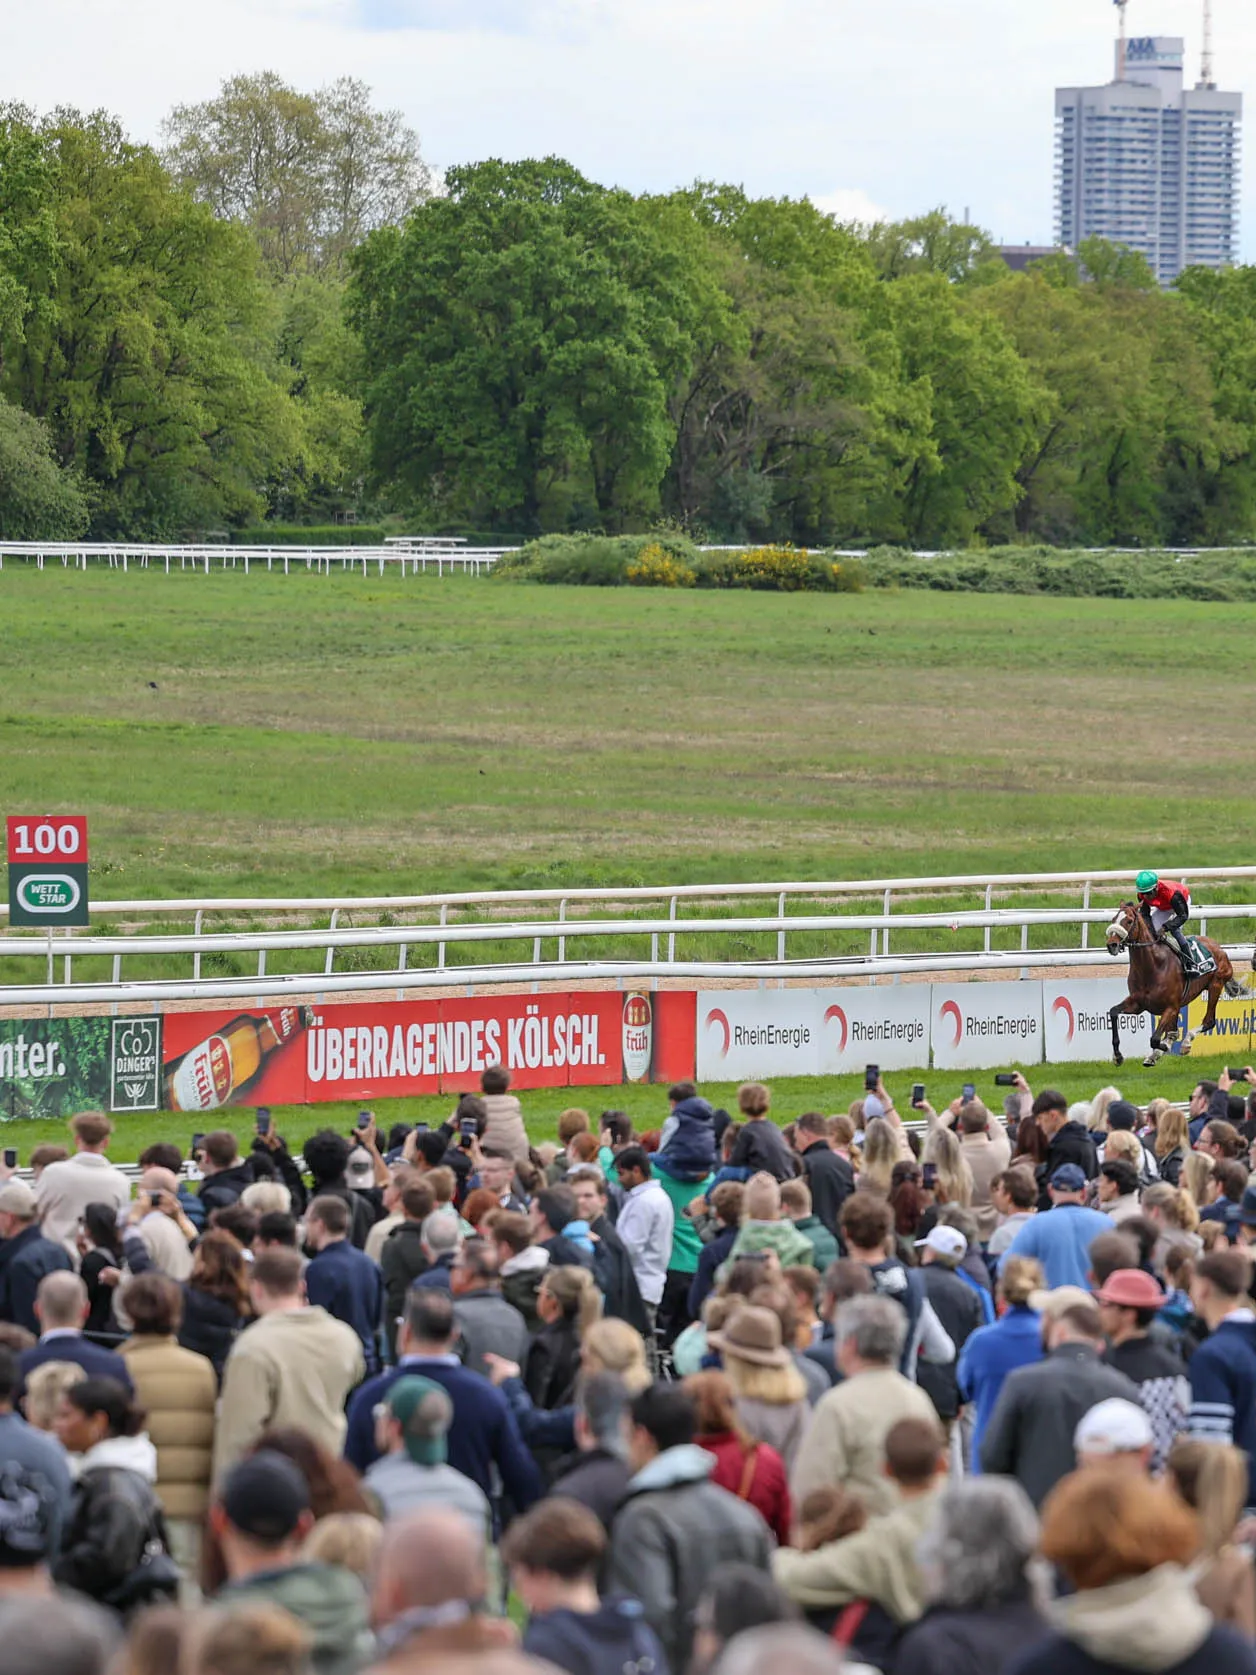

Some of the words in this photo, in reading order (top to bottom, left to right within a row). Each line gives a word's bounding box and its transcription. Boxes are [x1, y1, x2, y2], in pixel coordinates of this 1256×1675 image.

[15, 825, 79, 854] 100
[31, 884, 61, 894] WETT
[39, 894, 66, 904] STAR
[1191, 941, 1206, 962] 1
[734, 1025, 811, 1048] RheinEnergie
[852, 1019, 924, 1043] RheinEnergie
[966, 1015, 1036, 1038] RheinEnergie
[307, 1016, 501, 1082] ÜBERRAGENDES
[508, 1005, 605, 1069] KÖLSCH.
[626, 1029, 648, 1051] früh
[194, 1052, 214, 1108] früh
